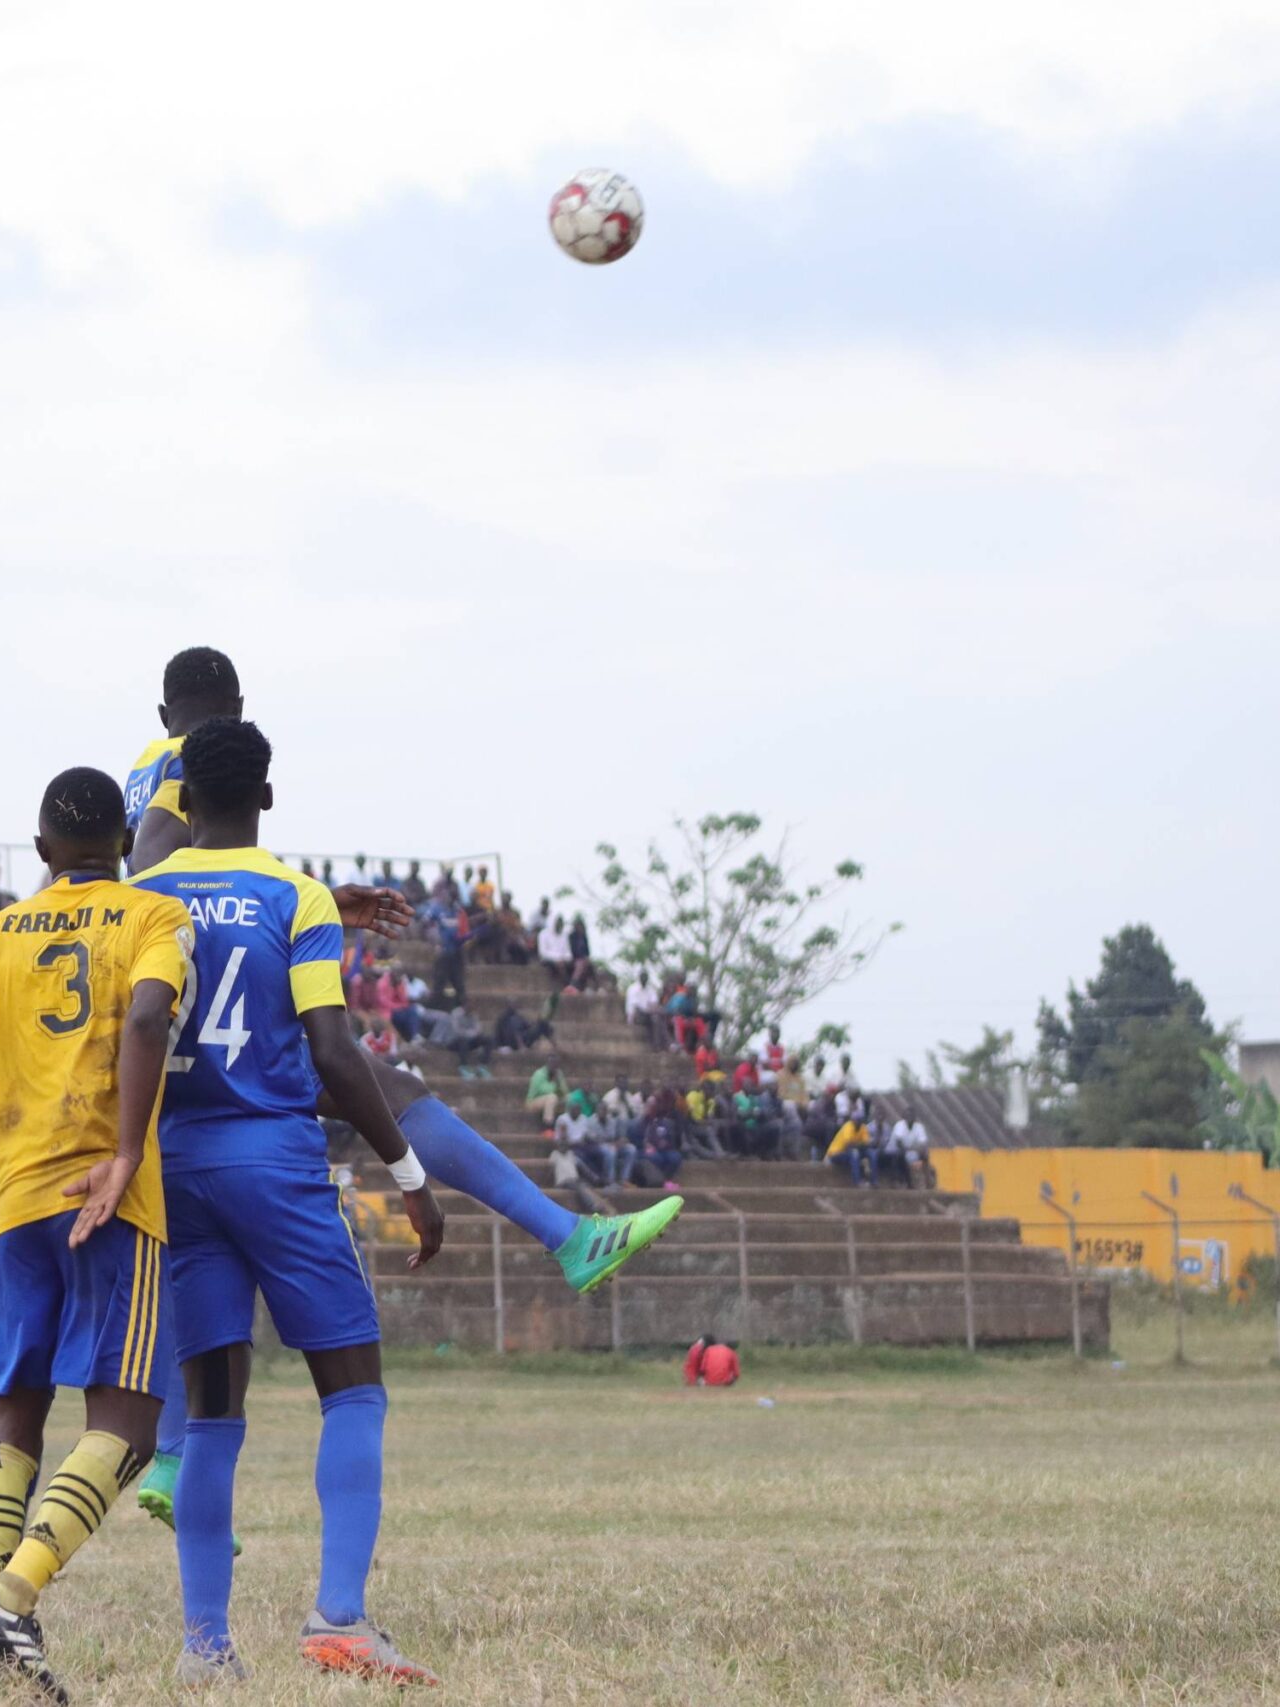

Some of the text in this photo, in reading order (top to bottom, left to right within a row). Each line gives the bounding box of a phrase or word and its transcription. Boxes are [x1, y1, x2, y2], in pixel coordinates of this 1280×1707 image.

[1, 907, 125, 933] FARAJI M
[176, 896, 261, 932] ANDE
[34, 937, 94, 1037] 3
[166, 946, 252, 1072] 24
